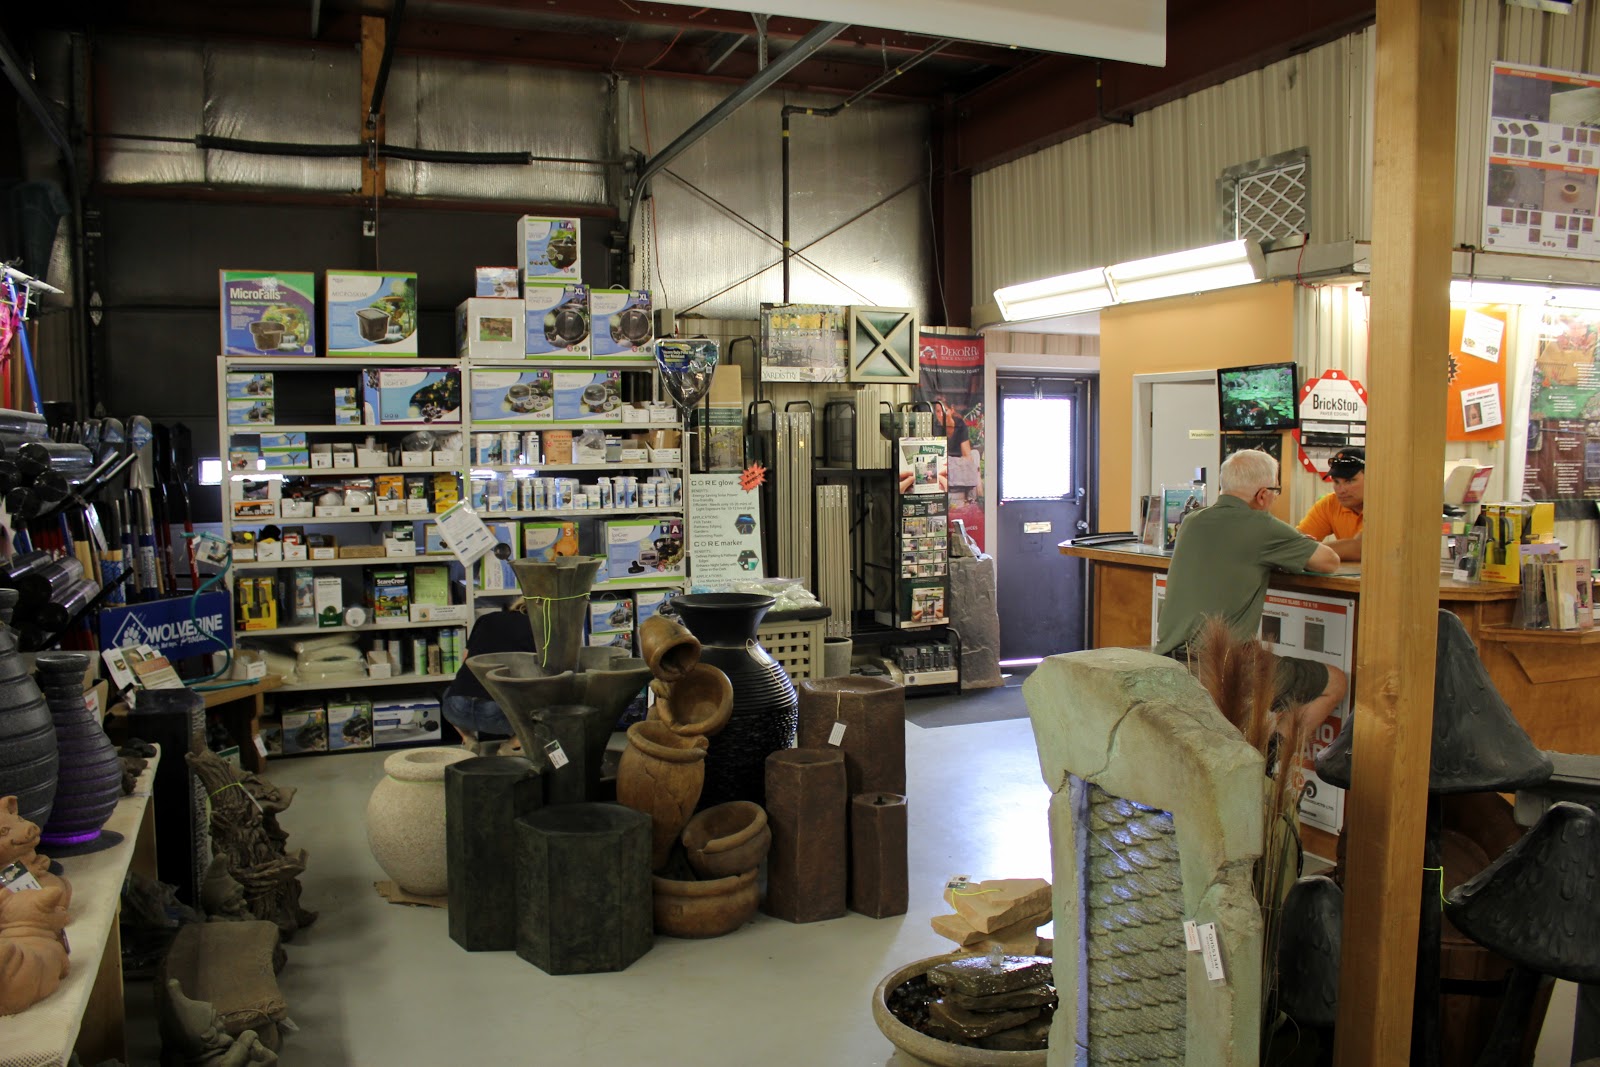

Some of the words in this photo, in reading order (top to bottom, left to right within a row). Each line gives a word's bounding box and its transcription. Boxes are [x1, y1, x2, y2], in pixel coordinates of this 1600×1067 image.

[230, 288, 280, 300] MicroFalls
[1313, 394, 1358, 414] BrickStop
[148, 614, 223, 644] WOLVERINE
